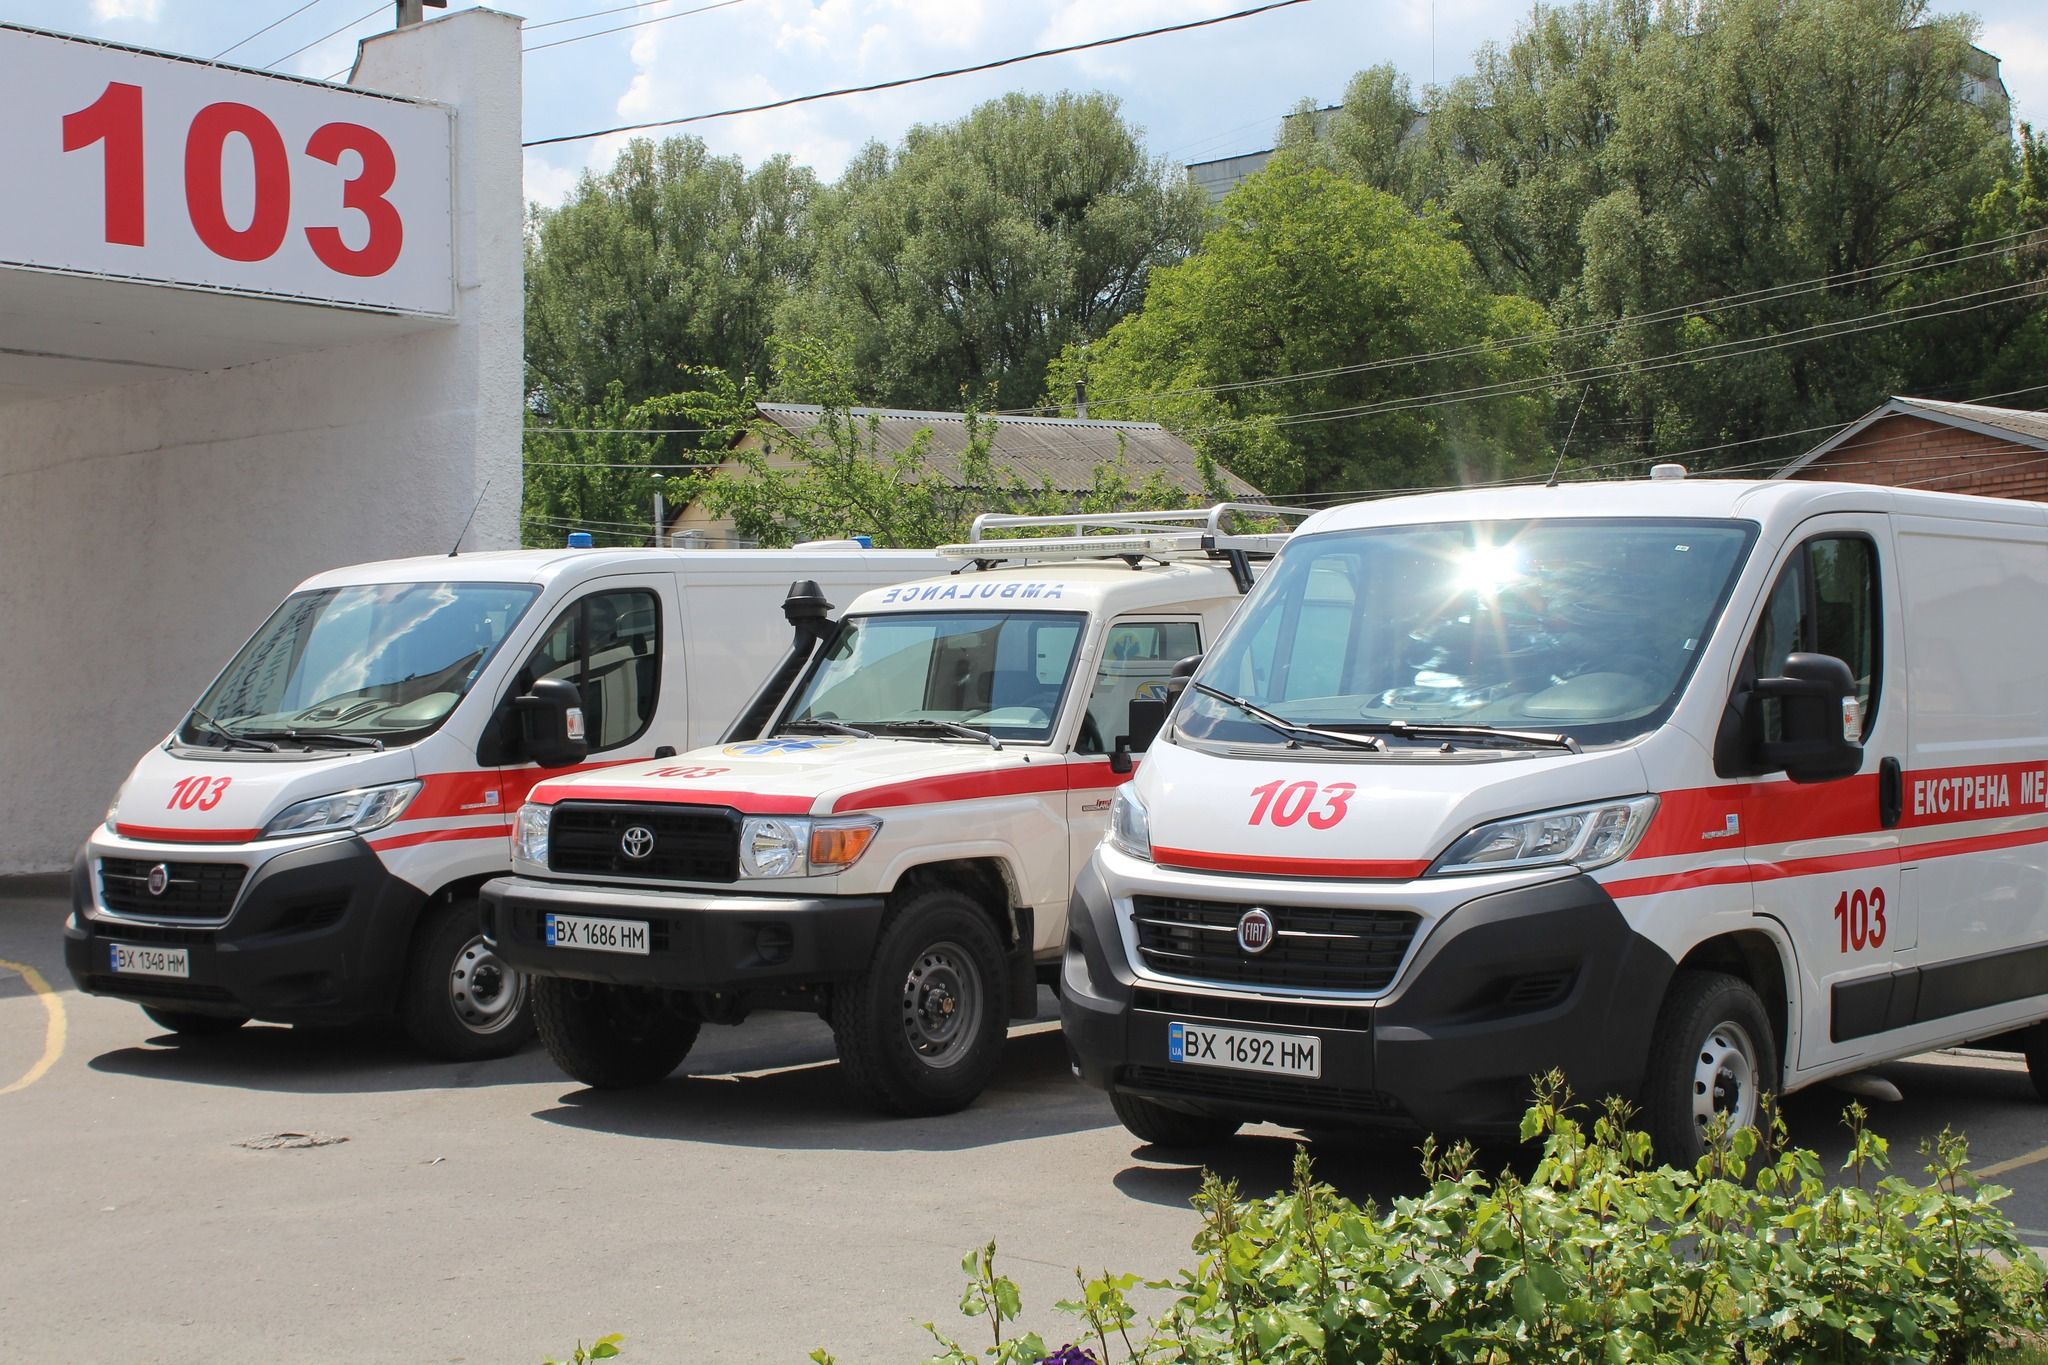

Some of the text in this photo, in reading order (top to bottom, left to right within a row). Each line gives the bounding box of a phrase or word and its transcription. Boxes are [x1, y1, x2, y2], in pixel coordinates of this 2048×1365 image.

[63, 81, 403, 277] 103
[642, 767, 731, 779] 103
[166, 776, 232, 811] 103
[1248, 780, 1357, 830] 103
[1914, 774, 2009, 815] ЕКСТРЕНА
[583, 923, 617, 946] 1686
[1245, 922, 1265, 941] FIAT
[1834, 887, 1886, 953] 103
[139, 952, 164, 970] 1348
[1225, 1036, 1274, 1066] 1692
